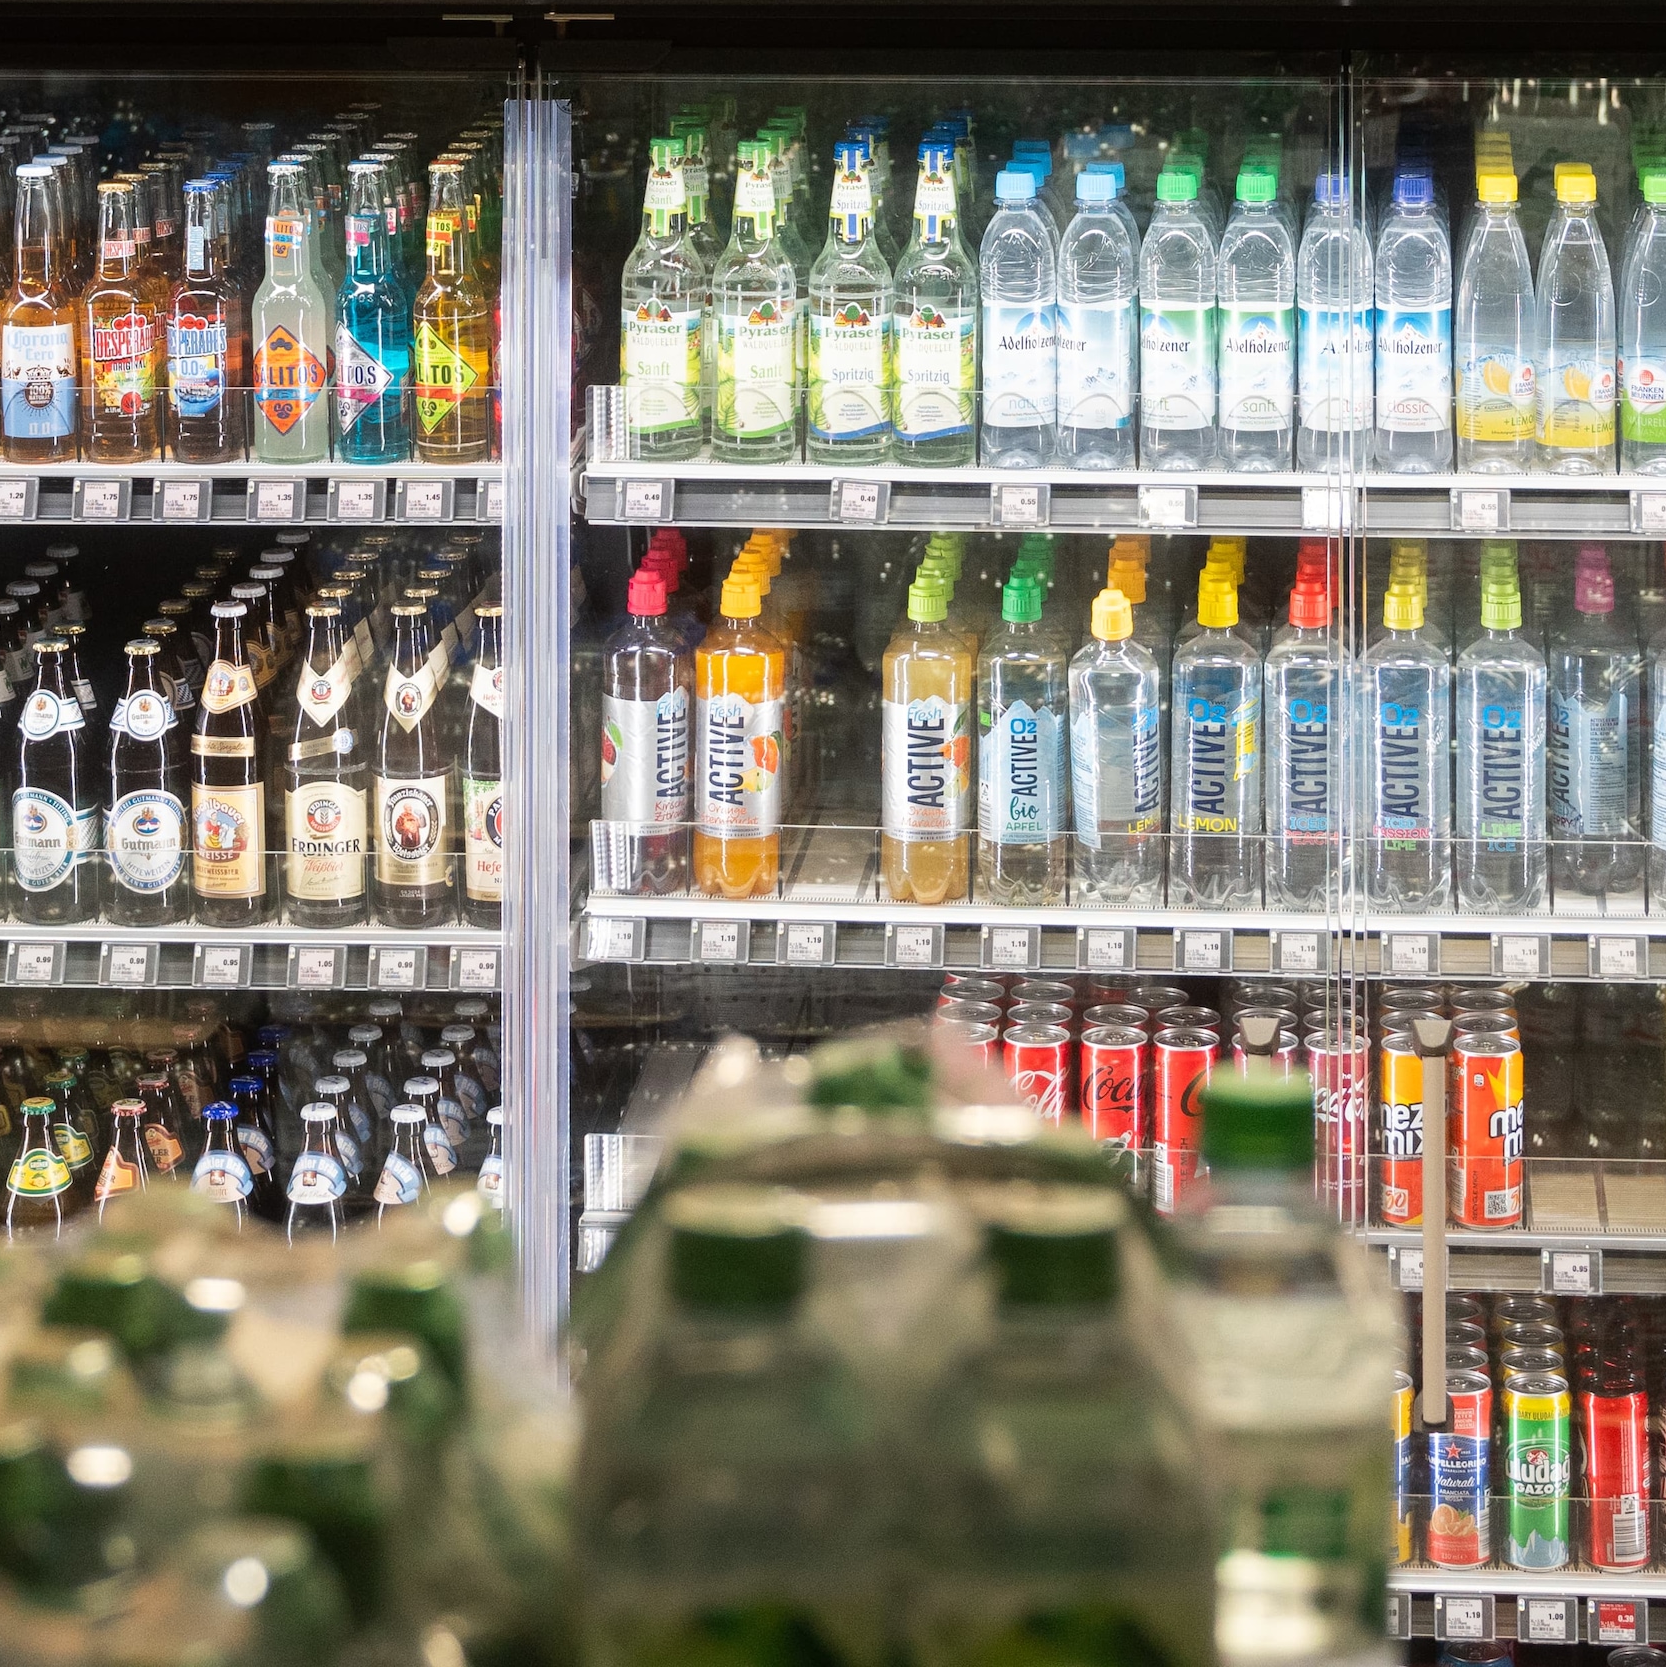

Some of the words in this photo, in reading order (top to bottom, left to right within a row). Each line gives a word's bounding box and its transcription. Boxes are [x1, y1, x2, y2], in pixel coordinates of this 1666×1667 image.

[650, 194, 674, 206] Sanft
[836, 199, 868, 210] Spritzig
[628, 321, 683, 336] Pyraser
[738, 324, 790, 338] Pyraser
[902, 328, 956, 341] Pyraser
[1224, 338, 1291, 354] Adelholzener
[181, 358, 208, 376] 0.0%
[254, 362, 318, 386] SALITOS
[637, 360, 670, 377] Sanft
[749, 364, 783, 379] Sanft
[832, 368, 875, 383] Spritzig
[908, 369, 951, 385] Spritzig
[1630, 391, 1665, 401] BRUNNEN
[1242, 400, 1277, 413] sanft
[1386, 400, 1430, 415] classic
[103, 493, 118, 501] 1.75
[426, 493, 440, 501] 1.45
[644, 493, 660, 501] 0.49
[860, 495, 876, 503] 0.49
[1020, 498, 1037, 506] 0.55
[1481, 503, 1497, 511] 0.55
[656, 695, 686, 719] Fresh
[708, 700, 742, 720] Fresh
[906, 706, 943, 722] Fresh
[708, 713, 744, 806] ACTIVE
[906, 718, 945, 809] ACTIVE
[1010, 732, 1038, 798] ACTIVE
[1380, 724, 1419, 818] ACTIVE
[1482, 728, 1521, 821] ACTIVE
[308, 799, 341, 817] ERDINGER
[1010, 793, 1040, 822] bio
[901, 816, 953, 828] Maracuja
[1005, 821, 1043, 832] APFEL
[1178, 816, 1237, 832] LEMON
[1481, 822, 1522, 836] LIME
[1373, 826, 1430, 839] PASSION
[120, 835, 176, 850] Gutmann
[291, 837, 361, 856] ERDINGER
[1383, 839, 1417, 851] LIME
[1486, 837, 1516, 852] ICE
[304, 857, 344, 873] Weißbier
[720, 934, 736, 943] 1.19
[915, 938, 931, 946] 1.19
[1300, 944, 1316, 953] 1.19
[129, 957, 145, 965] 0.99
[318, 960, 333, 968] 1.05
[1572, 1264, 1588, 1273] 0.95
[1547, 1612, 1564, 1621] 1.09
